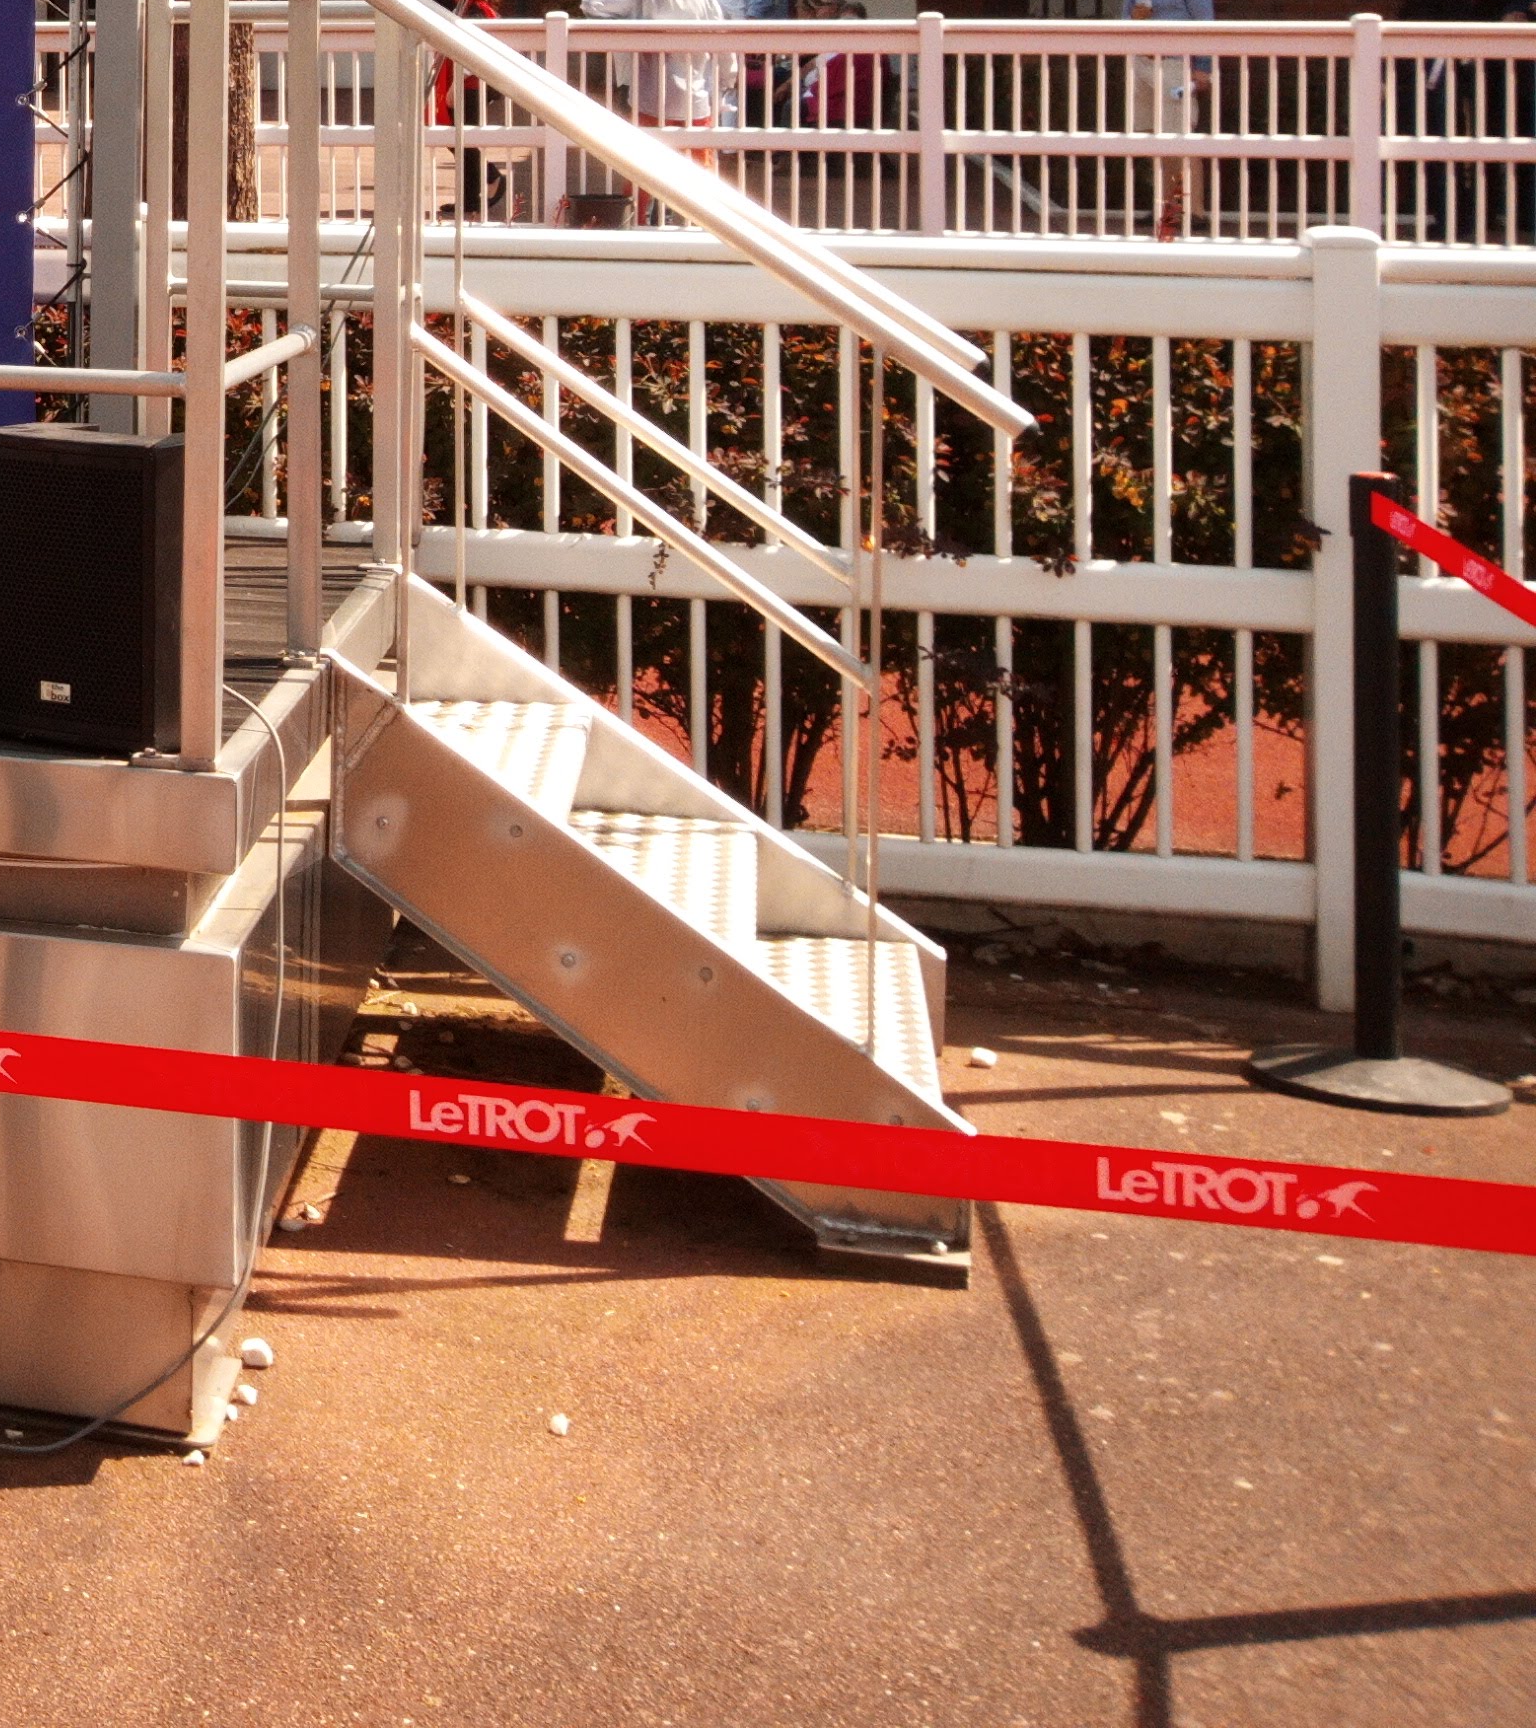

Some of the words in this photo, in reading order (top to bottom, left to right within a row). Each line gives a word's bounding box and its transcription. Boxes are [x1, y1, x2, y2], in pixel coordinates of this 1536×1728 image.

[51, 690, 70, 702] box
[410, 1090, 586, 1145] LeTROT
[1097, 1158, 1297, 1215] LeTROT
